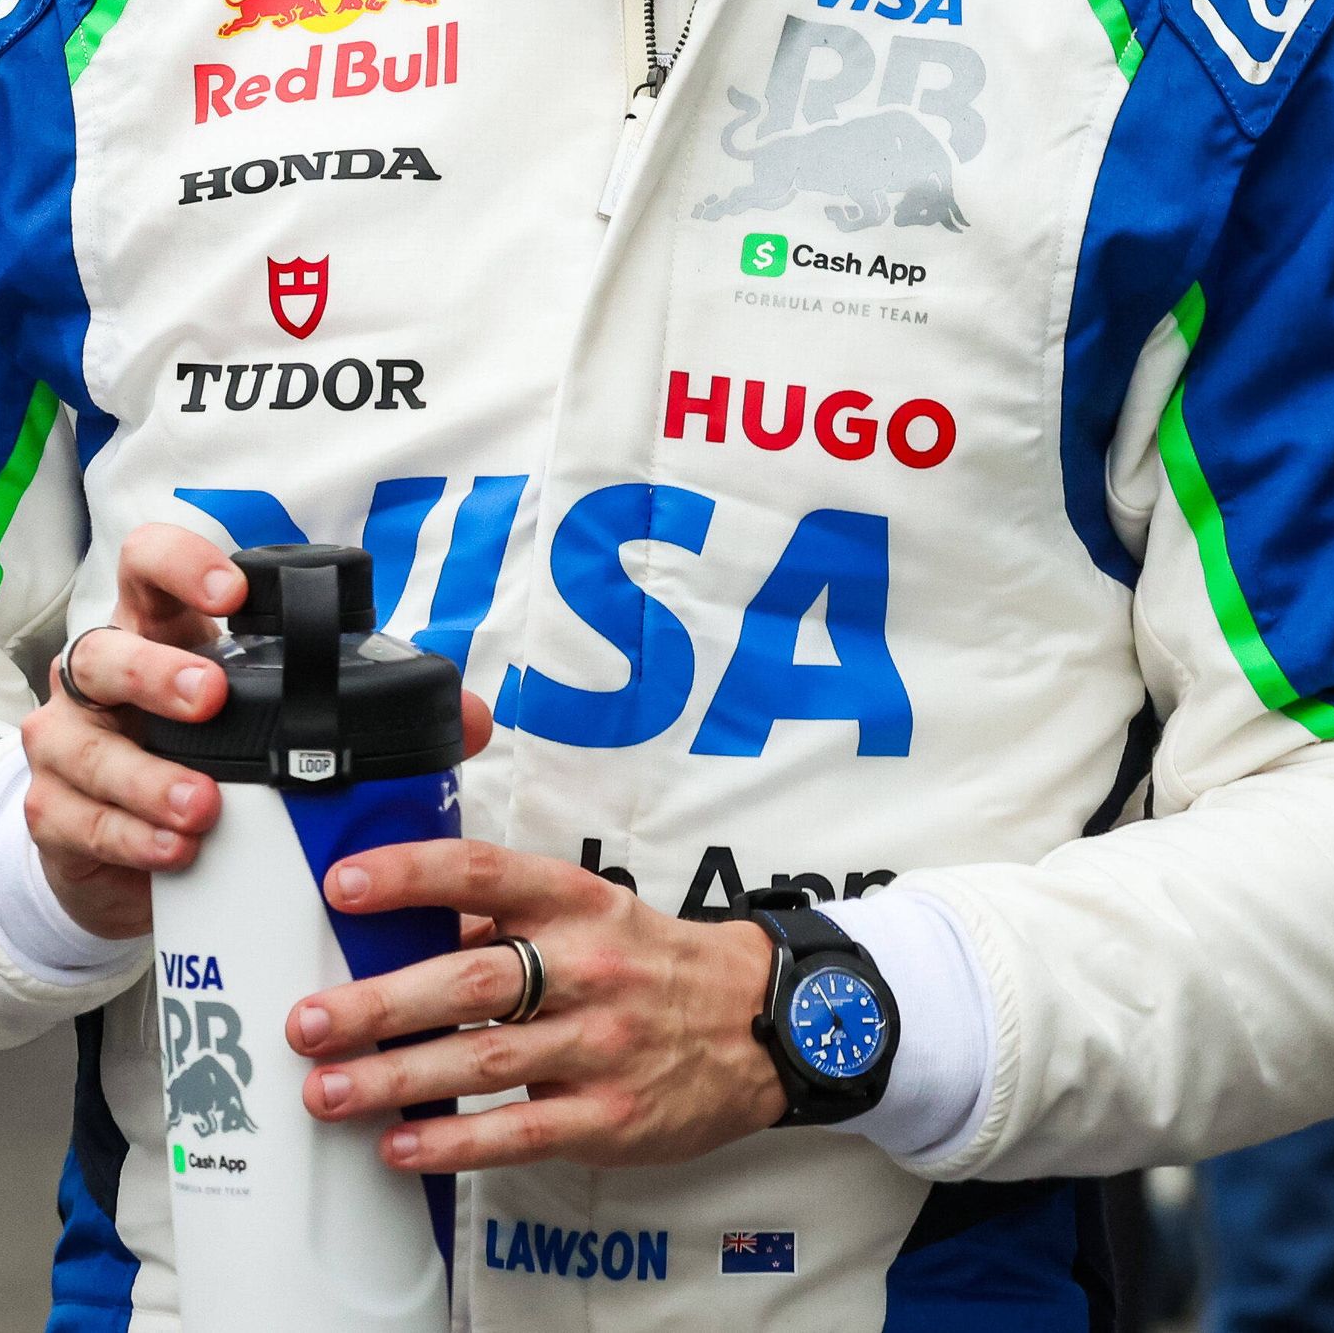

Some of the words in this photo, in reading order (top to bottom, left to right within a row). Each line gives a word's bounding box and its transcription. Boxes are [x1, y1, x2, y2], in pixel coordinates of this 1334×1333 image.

[193, 42, 322, 125] Red
[331, 21, 459, 100] Bull
[178, 147, 443, 205] HONDA
[792, 244, 862, 276] Cash
[867, 254, 927, 287] App
[734, 290, 824, 313] FORMULA
[832, 300, 871, 318] ONE
[879, 305, 929, 325] TEAM
[176, 357, 427, 412] TUDOR
[664, 370, 957, 470] HUGO
[299, 758, 331, 773] LOOP
[160, 951, 224, 991] VISA
[188, 1152, 217, 1169] Cash
[219, 1155, 247, 1174] App
[485, 1218, 669, 1282] LAWSON
